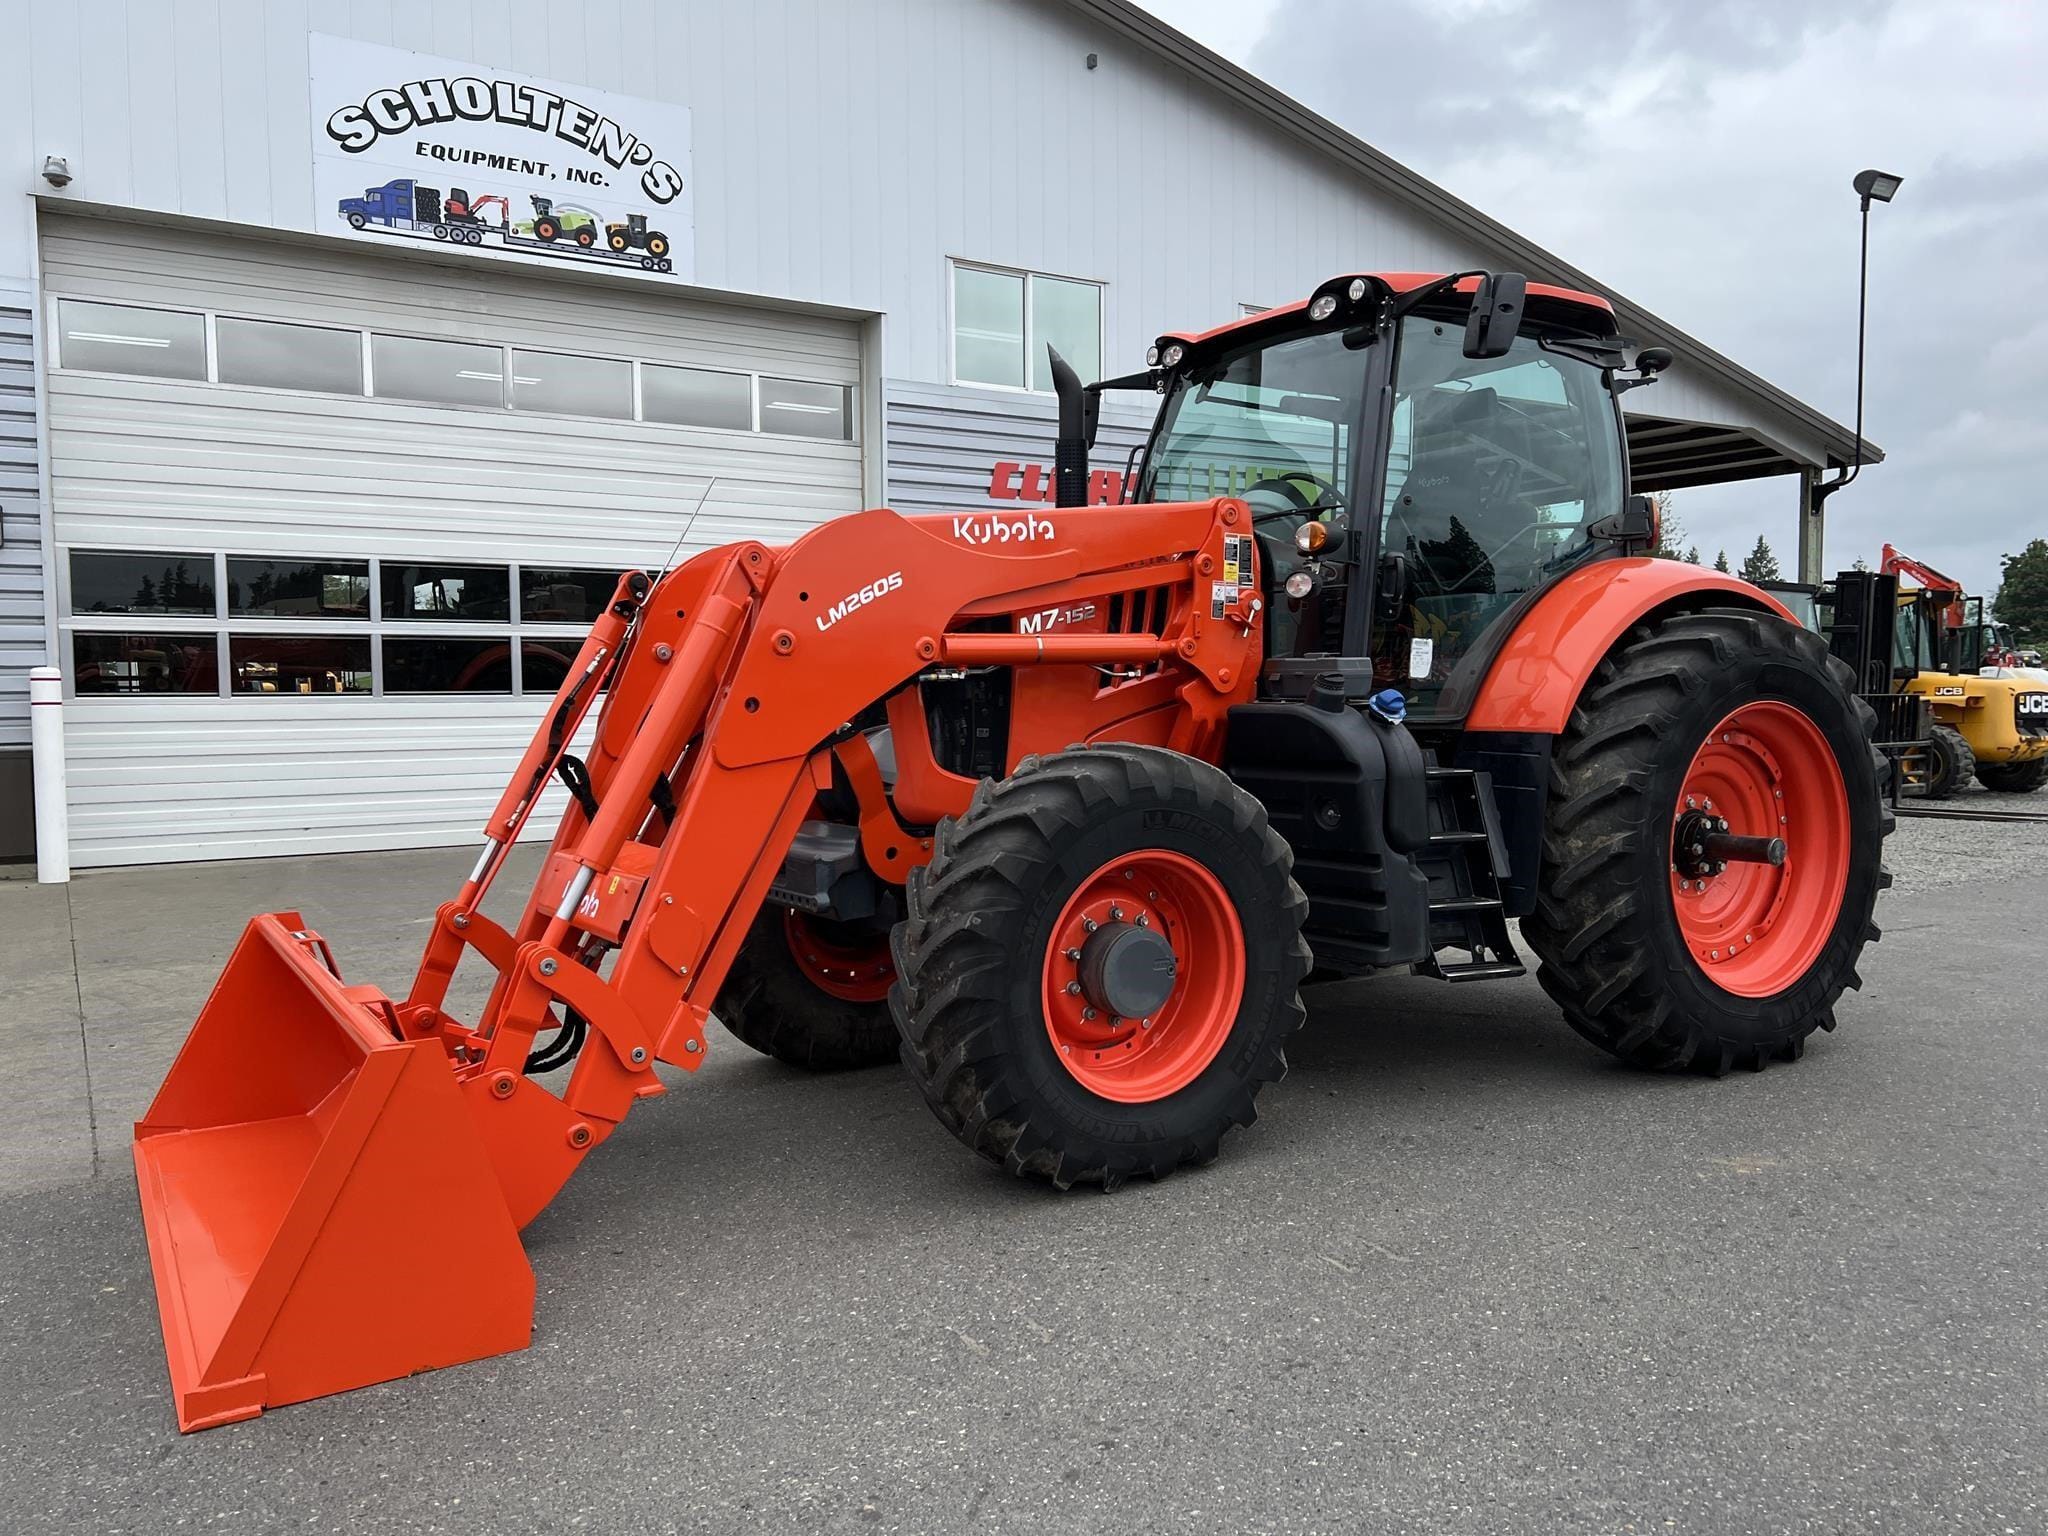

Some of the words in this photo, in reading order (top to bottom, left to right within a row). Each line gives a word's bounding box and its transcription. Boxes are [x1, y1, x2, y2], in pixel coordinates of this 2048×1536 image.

[326, 77, 683, 204] SCHOLTEN'S
[415, 141, 557, 181] EQUIPMENT,
[566, 167, 610, 187] INC.
[989, 462, 1138, 505] CLA
[953, 514, 1055, 545] Kubota
[816, 571, 904, 632] LM2605
[1019, 605, 1096, 634] M7-152
[1935, 687, 1963, 696] JCB
